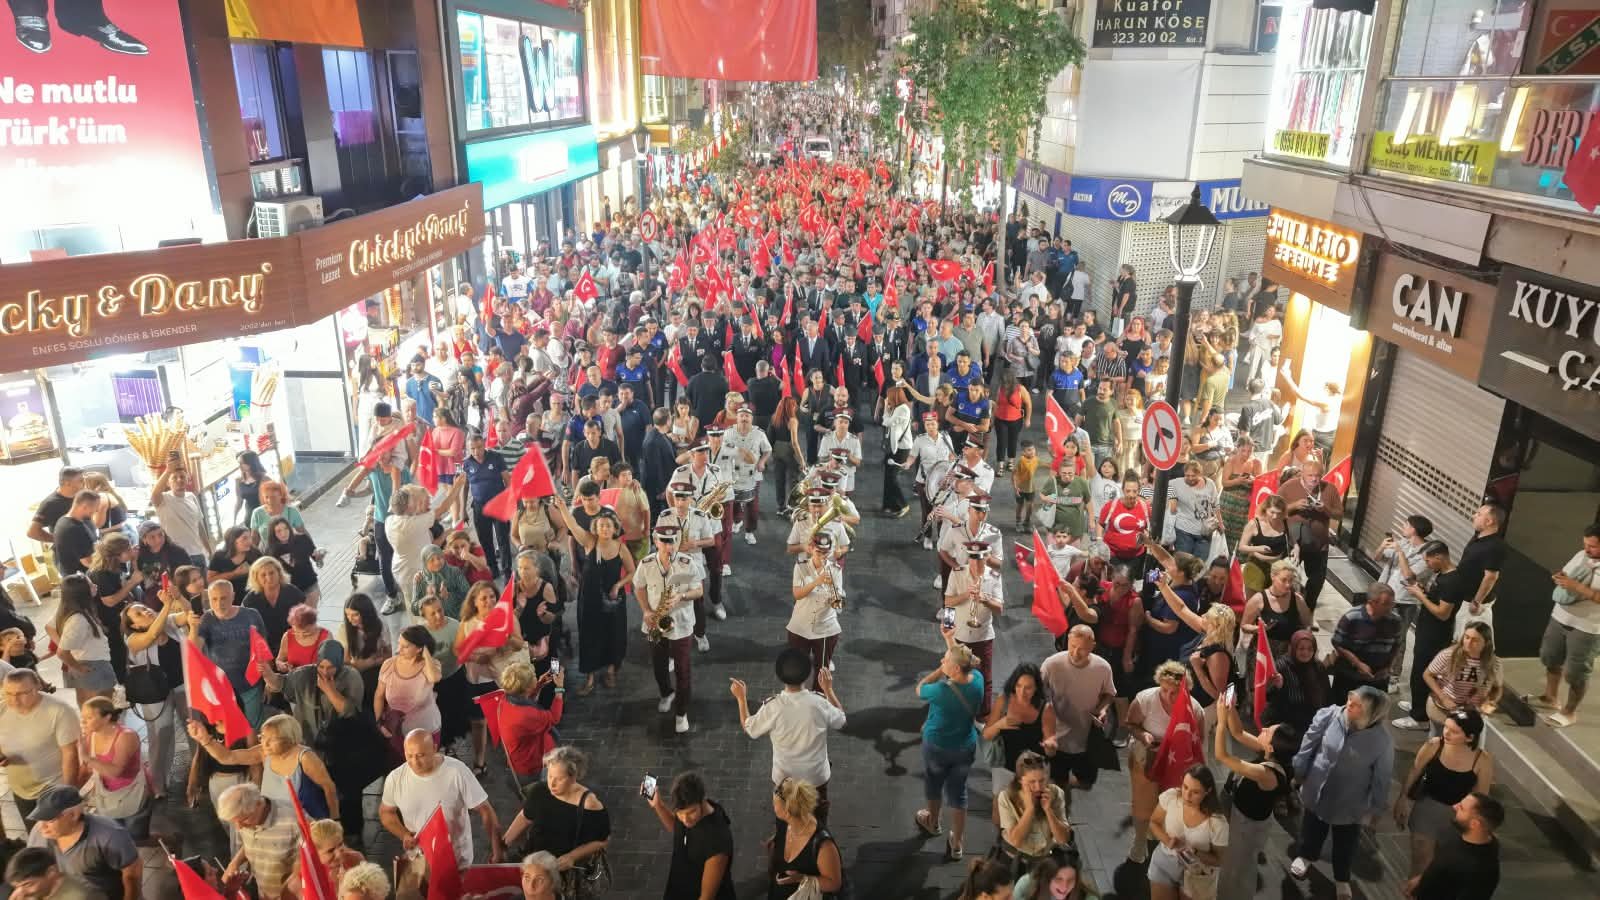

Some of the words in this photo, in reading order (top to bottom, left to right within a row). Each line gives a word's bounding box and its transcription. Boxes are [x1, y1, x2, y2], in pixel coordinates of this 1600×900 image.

[1096, 17, 1148, 31] HARUN
[1154, 14, 1206, 29] KÖSE
[1111, 32, 1135, 45] 323
[1138, 32, 1156, 44] 20
[1160, 32, 1177, 43] 02
[42, 76, 137, 103] mutlu
[0, 117, 127, 145] Türk'üm
[315, 252, 343, 270] Premium
[1274, 245, 1333, 280] PERFUME
[97, 285, 124, 317] &
[1392, 273, 1464, 338] CAN
[1508, 280, 1600, 347] KUY
[104, 331, 140, 345] DÖNER
[142, 331, 149, 340] &
[150, 324, 198, 338] İSKENDER
